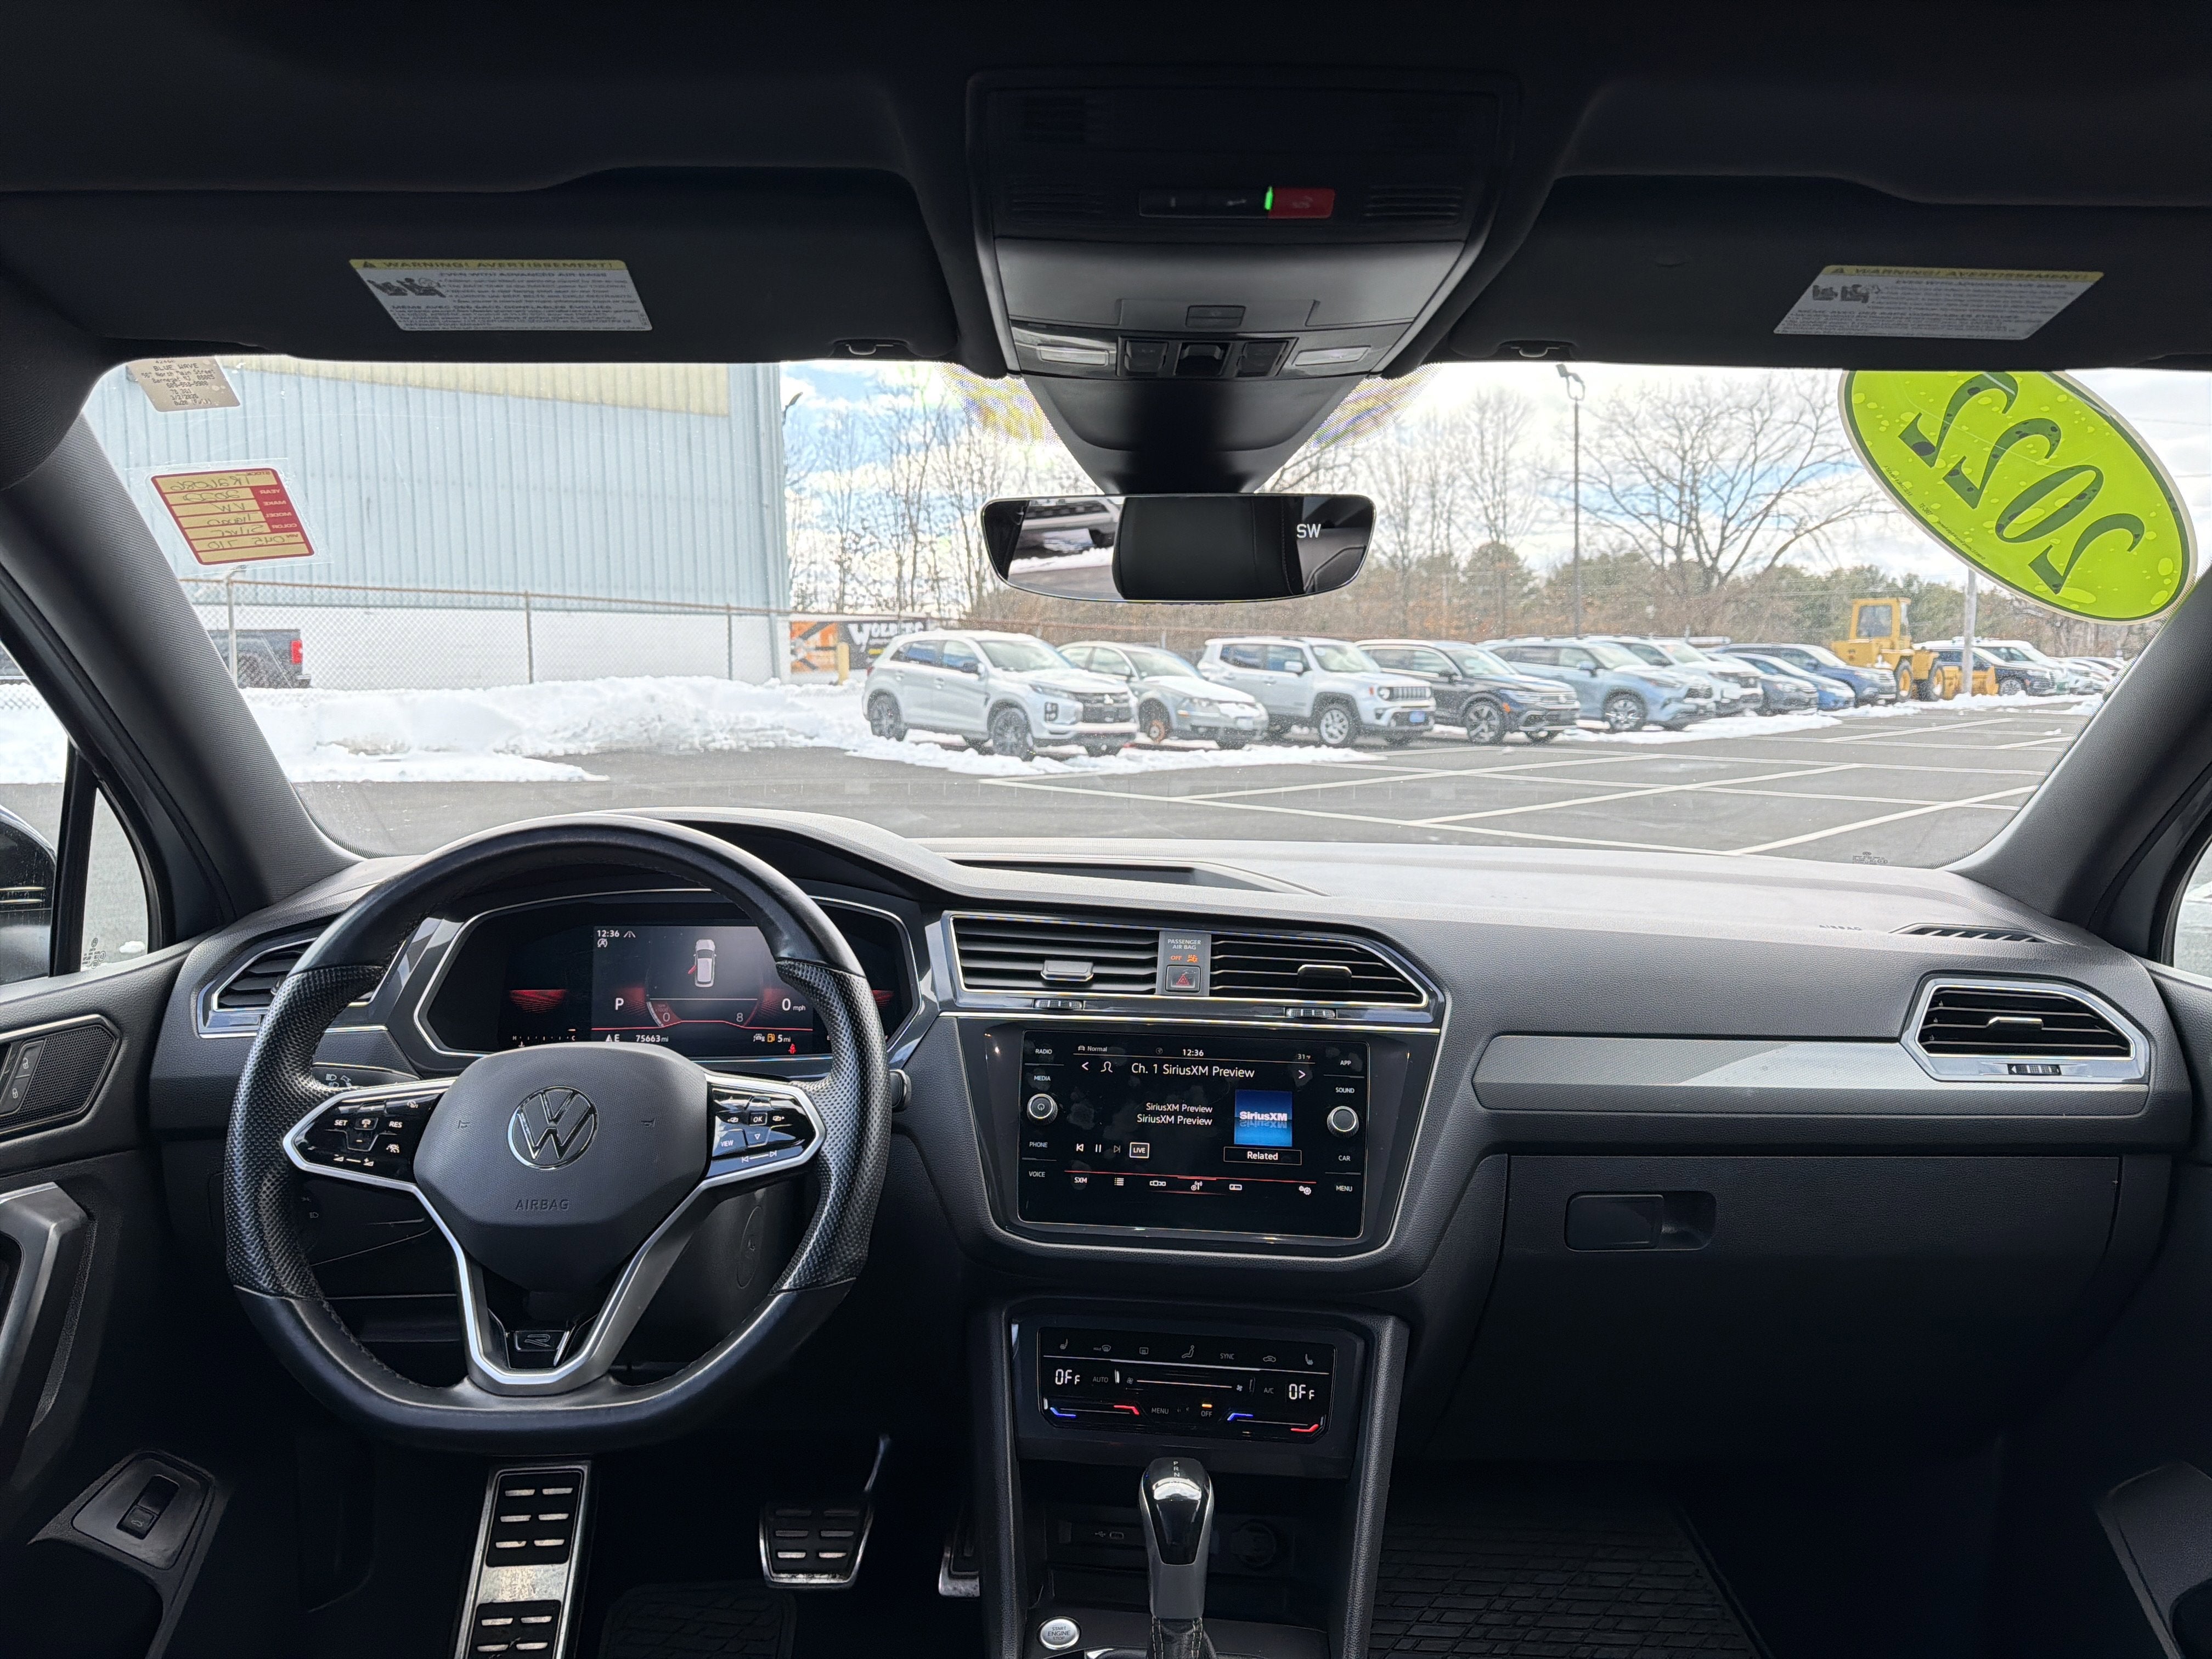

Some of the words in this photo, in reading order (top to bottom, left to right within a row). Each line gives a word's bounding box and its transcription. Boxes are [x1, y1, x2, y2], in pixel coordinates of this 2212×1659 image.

[1296, 523, 1322, 538] SW
[615, 998, 624, 1011] P
[782, 998, 791, 1011] 0
[663, 1012, 670, 1022] 0
[736, 1013, 744, 1022] 8
[1131, 1063, 1148, 1074] Ch.
[1153, 1064, 1158, 1074] 1
[1163, 1064, 1209, 1076] SiriusXM
[1212, 1066, 1255, 1077] Preview
[1146, 1103, 1179, 1112] SiriusXM
[1182, 1104, 1212, 1113] Preview
[1137, 1114, 1175, 1124] SiriusXM
[1177, 1115, 1212, 1125] Preview
[1239, 1111, 1288, 1121] SiriusXM
[1247, 1151, 1278, 1160] Related
[516, 1199, 570, 1211] AIRBAG
